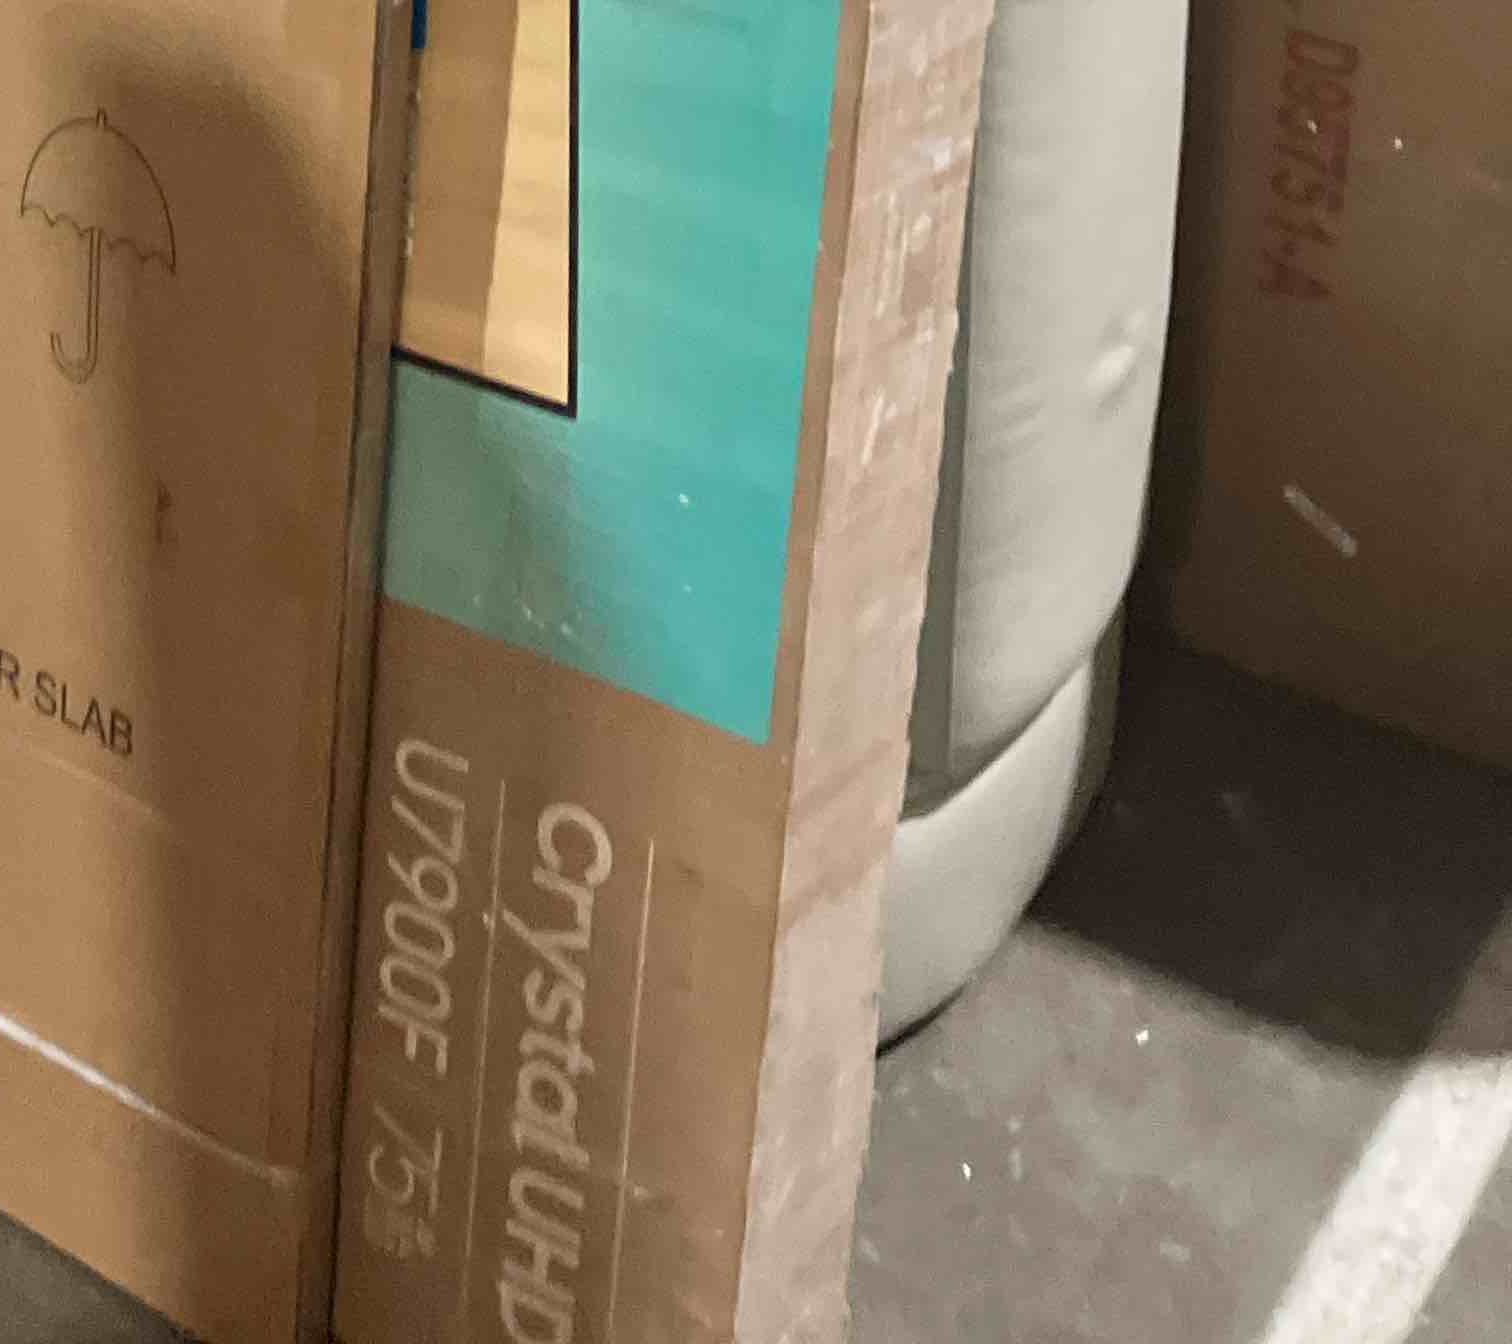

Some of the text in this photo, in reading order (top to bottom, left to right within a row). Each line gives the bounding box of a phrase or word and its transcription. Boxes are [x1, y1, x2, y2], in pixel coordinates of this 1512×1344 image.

[33, 669, 134, 758] SLAB
[376, 738, 470, 1079] U7900F
[496, 801, 613, 1344] Crystal UHD
